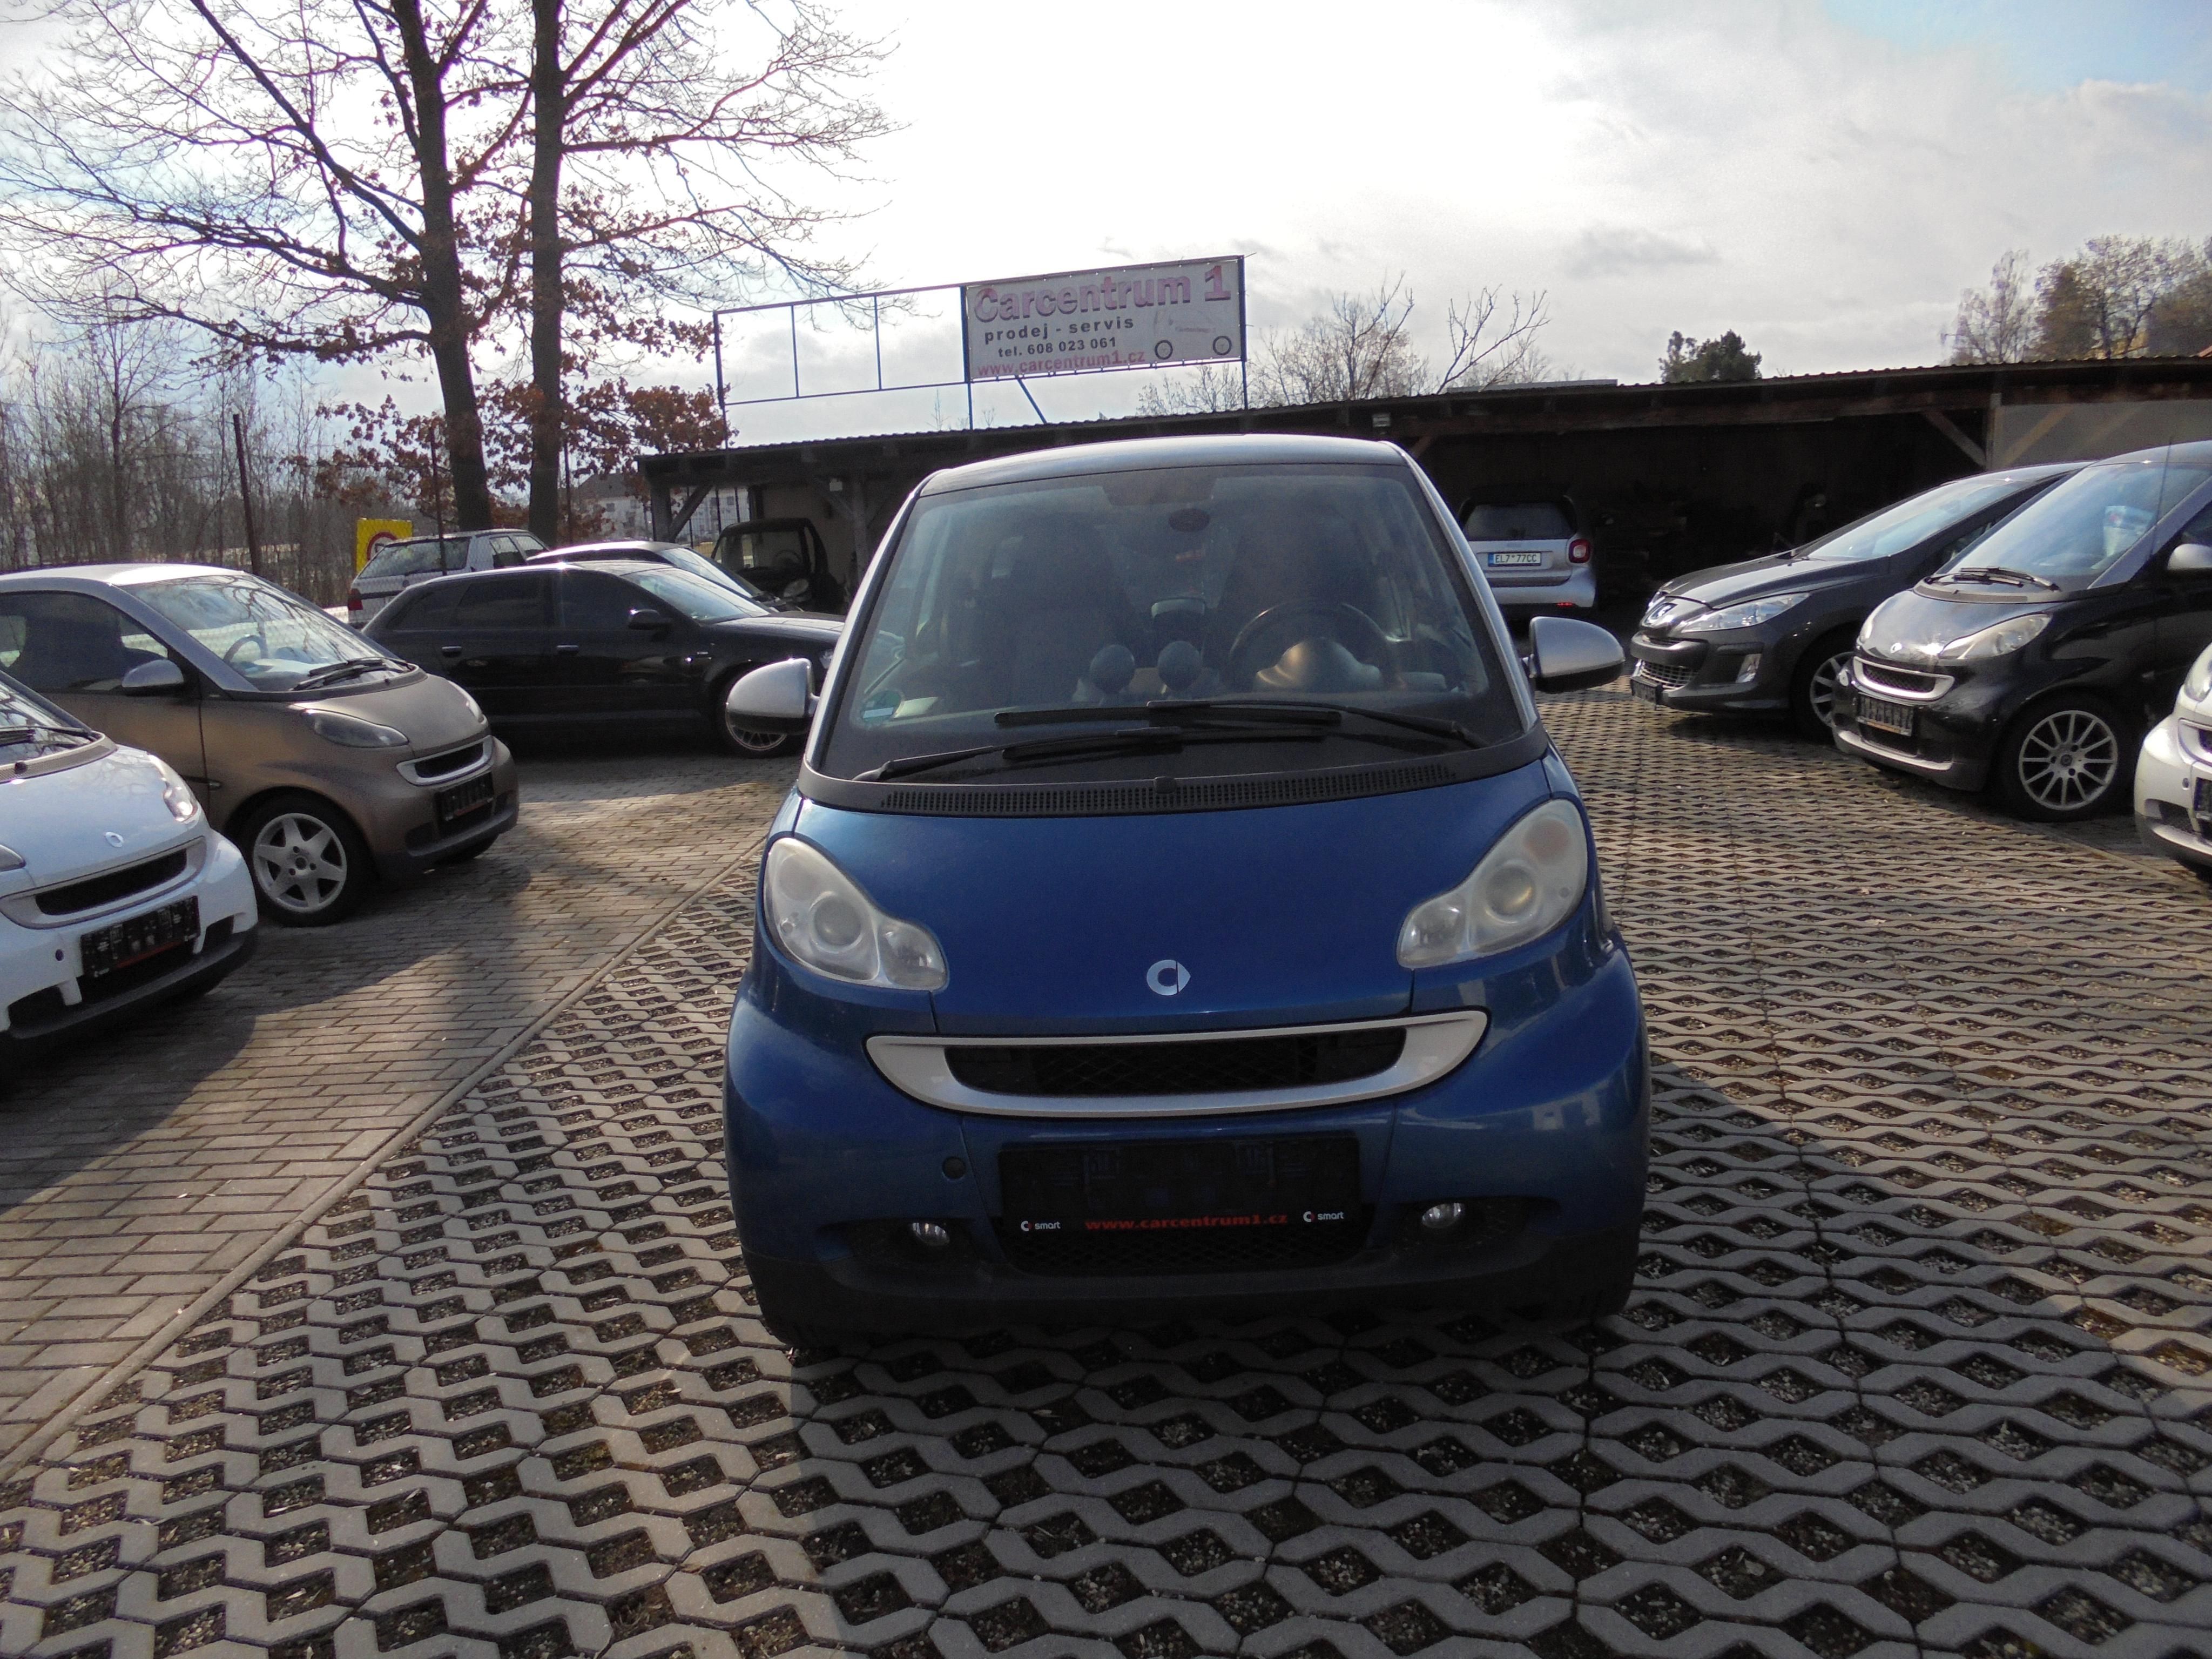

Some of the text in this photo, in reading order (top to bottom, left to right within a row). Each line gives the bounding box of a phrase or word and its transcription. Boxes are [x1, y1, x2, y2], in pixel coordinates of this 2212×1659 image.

[974, 265, 1231, 323] Carcentrum 1
[984, 324, 1048, 344] prodej
[1069, 316, 1134, 334] servis
[999, 337, 1116, 357] tel. 608 023 061
[977, 350, 1146, 376] www.carcentrum1.cz
[1034, 1221, 1061, 1230] smart
[1085, 1213, 1288, 1230] www.carcentrum1.cz
[1317, 1211, 1344, 1220] smart
